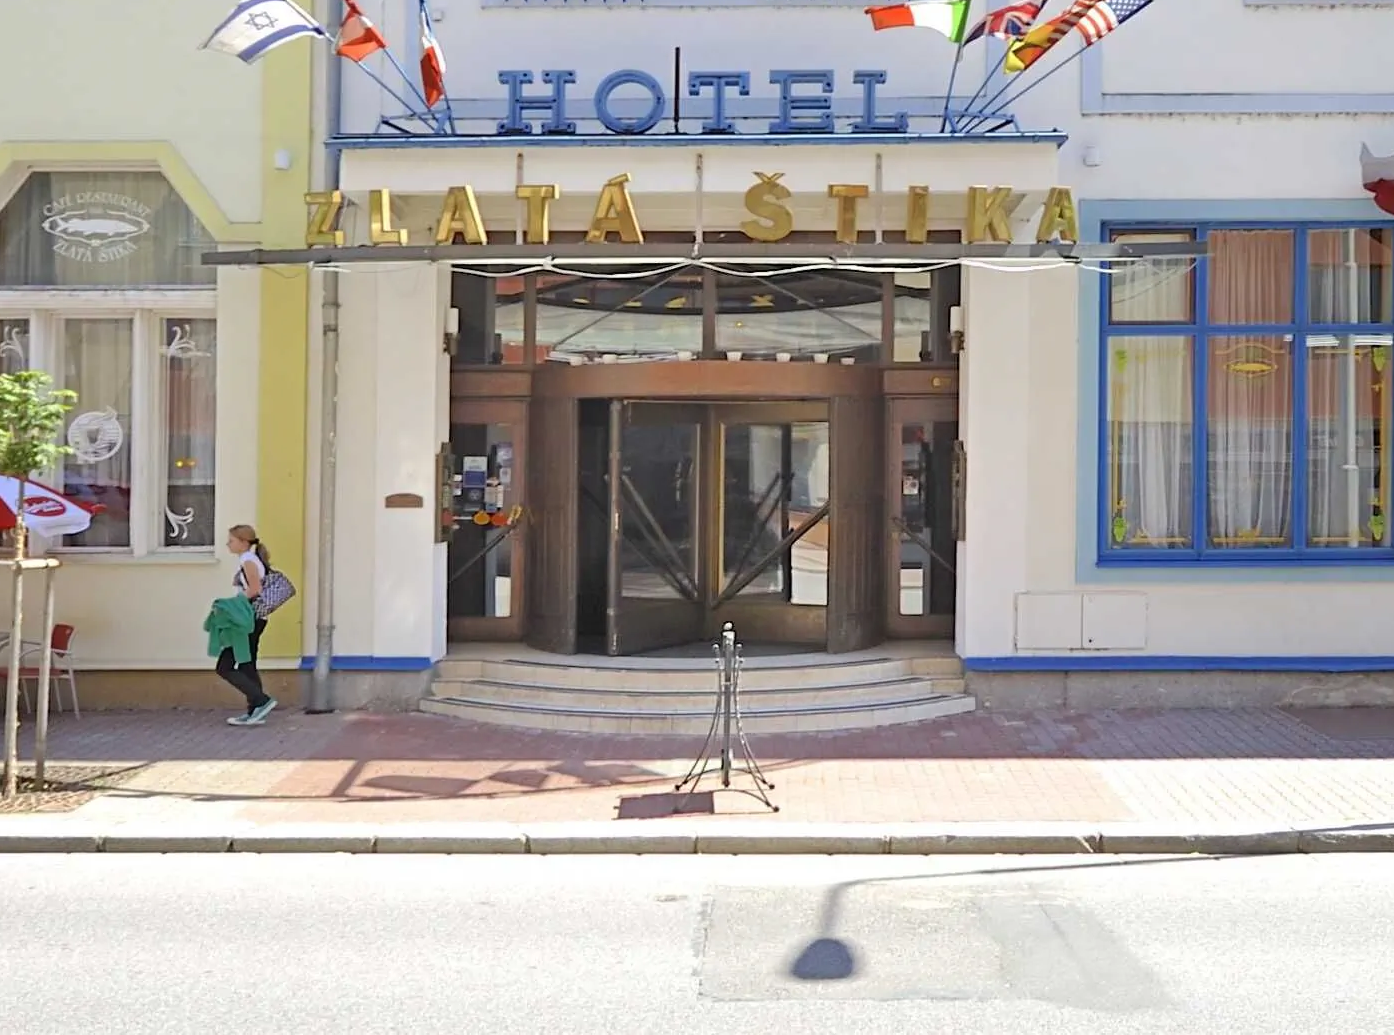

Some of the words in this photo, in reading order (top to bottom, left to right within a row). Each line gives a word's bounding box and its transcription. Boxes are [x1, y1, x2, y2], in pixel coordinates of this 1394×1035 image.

[496, 69, 909, 134] HOTEL
[304, 172, 644, 246] ZLATÁ
[740, 171, 1080, 245] ŠTIKA
